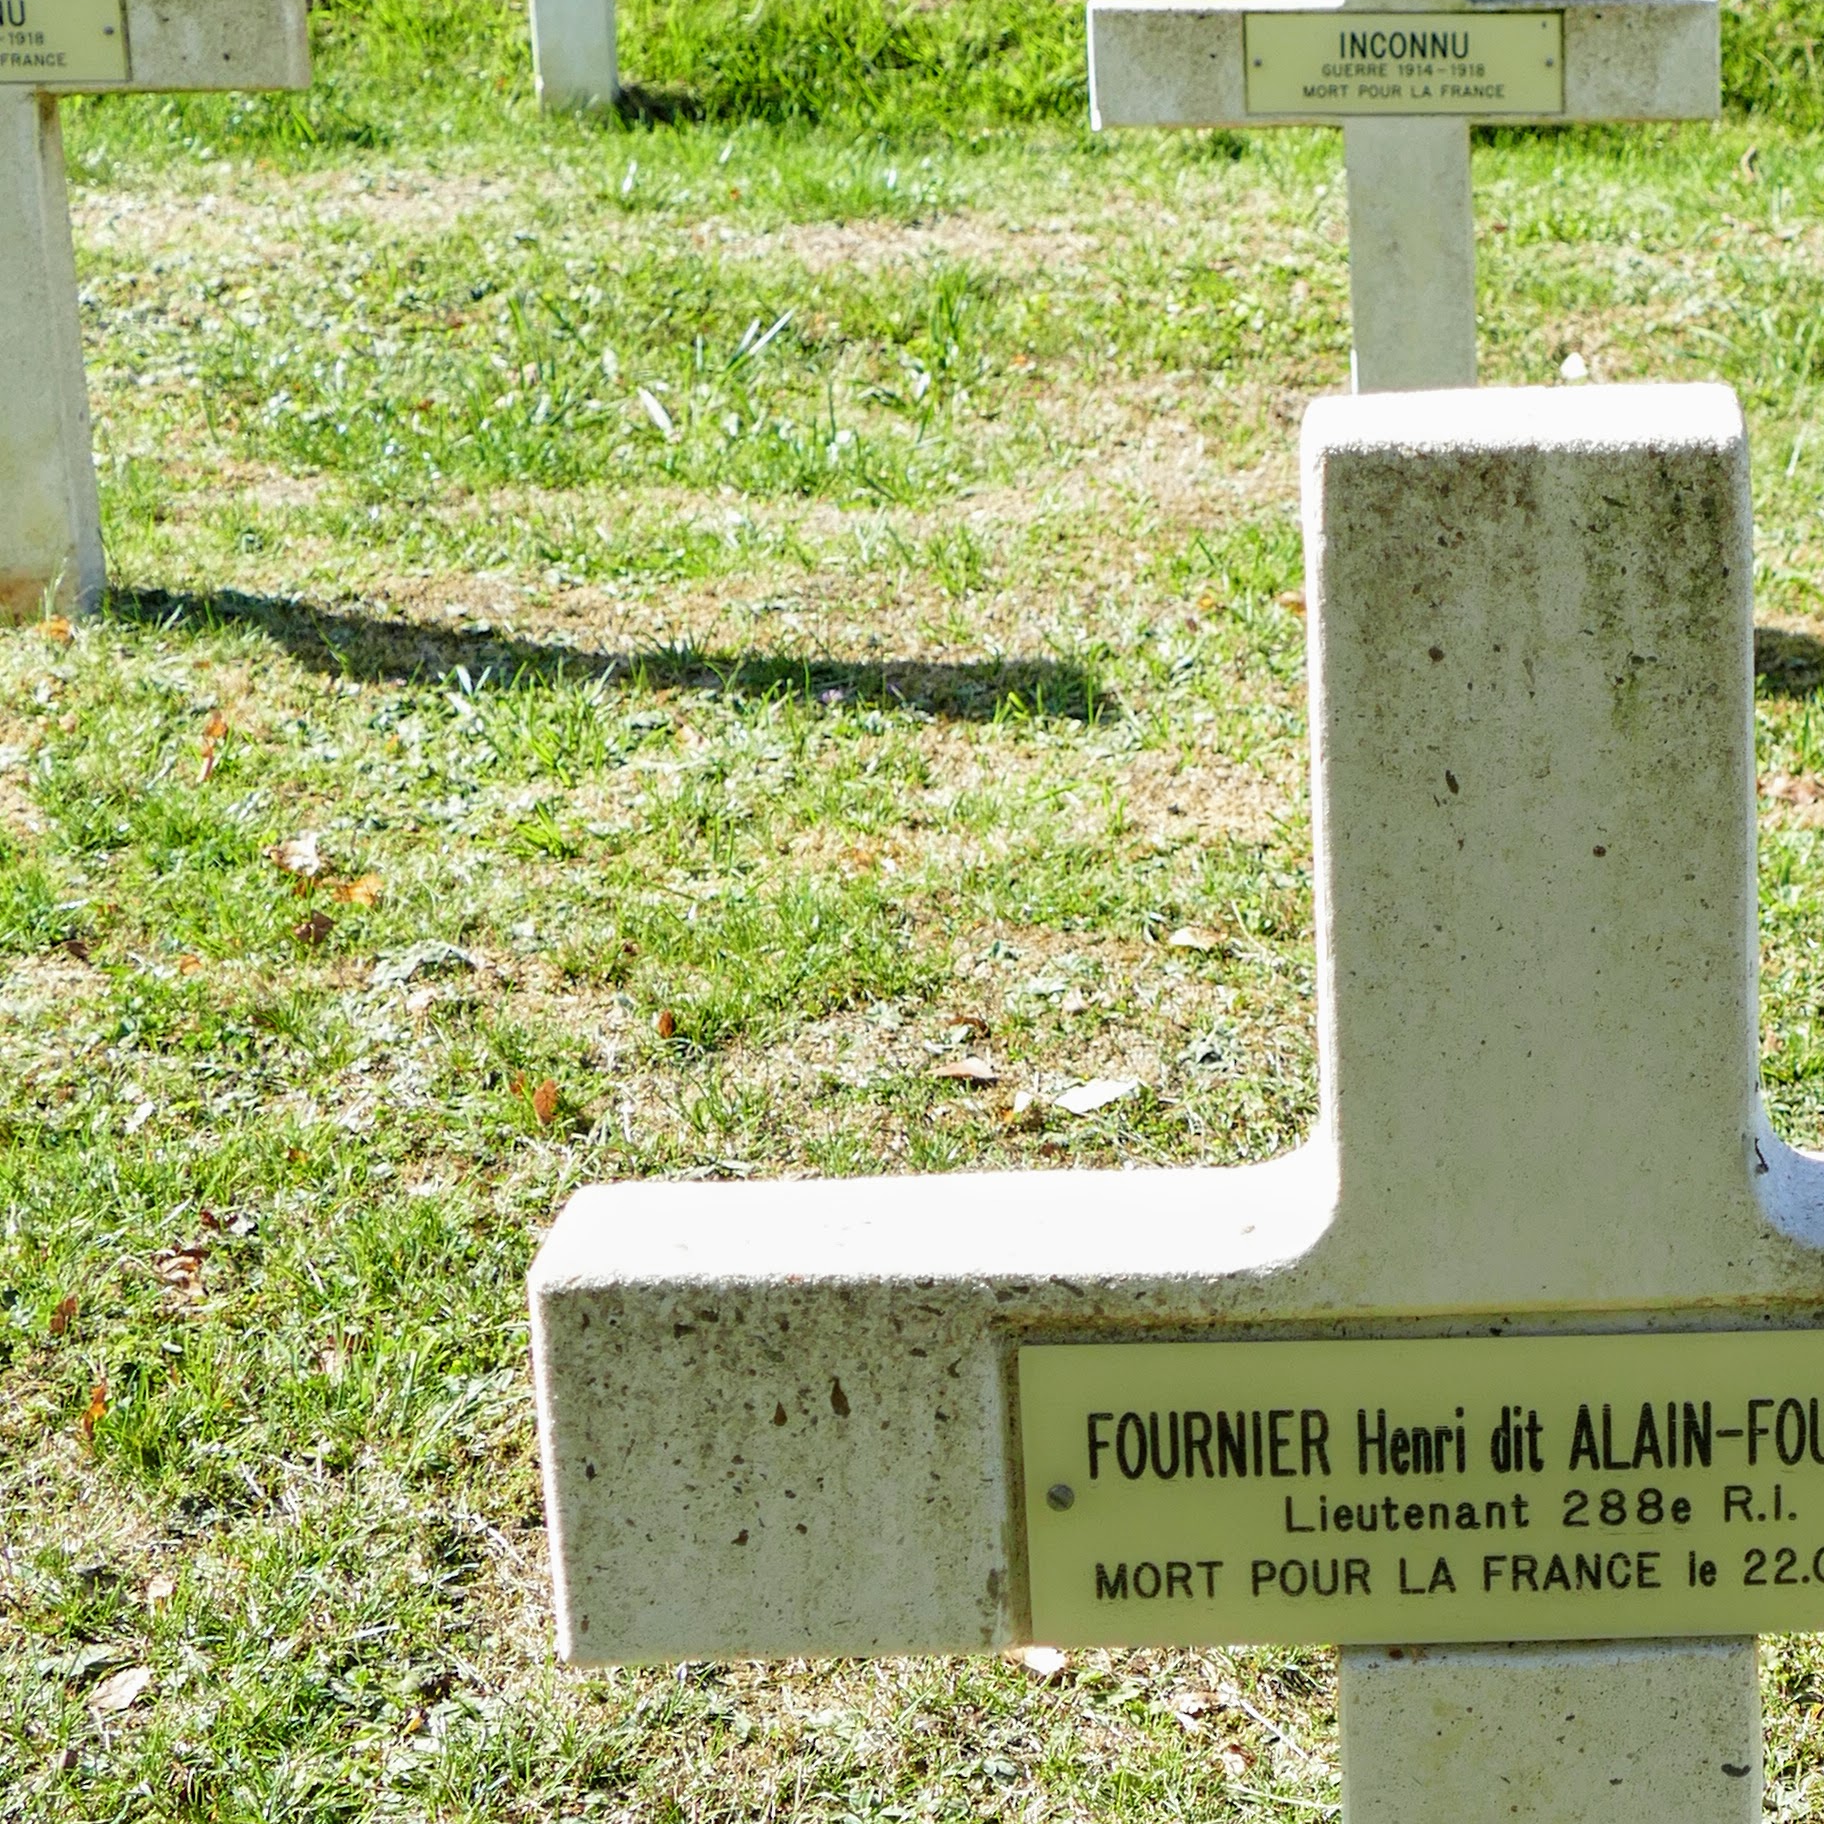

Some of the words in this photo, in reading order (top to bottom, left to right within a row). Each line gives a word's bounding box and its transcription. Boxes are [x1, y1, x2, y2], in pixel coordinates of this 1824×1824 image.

[0, 51, 67, 67] FRANCE
[1340, 31, 1470, 59] INCONNU
[1321, 62, 1388, 77] GUERRE
[1303, 84, 1349, 99] MORT
[1358, 84, 1402, 98] POUR
[1411, 84, 1432, 98] LA
[1440, 83, 1506, 99] FRANCE
[1087, 1408, 1331, 1479] FOURNIER
[1358, 1406, 1466, 1476] Henri
[1491, 1405, 1545, 1473] dit
[1285, 1493, 1529, 1533] Lieutenant
[1562, 1487, 1692, 1527] 288e
[1723, 1483, 1798, 1523] R.I.
[1095, 1560, 1223, 1600] MORT
[1251, 1557, 1372, 1597] POUR
[1400, 1556, 1456, 1595] LA
[1484, 1550, 1661, 1593] FRANCE
[1689, 1550, 1718, 1587] le
